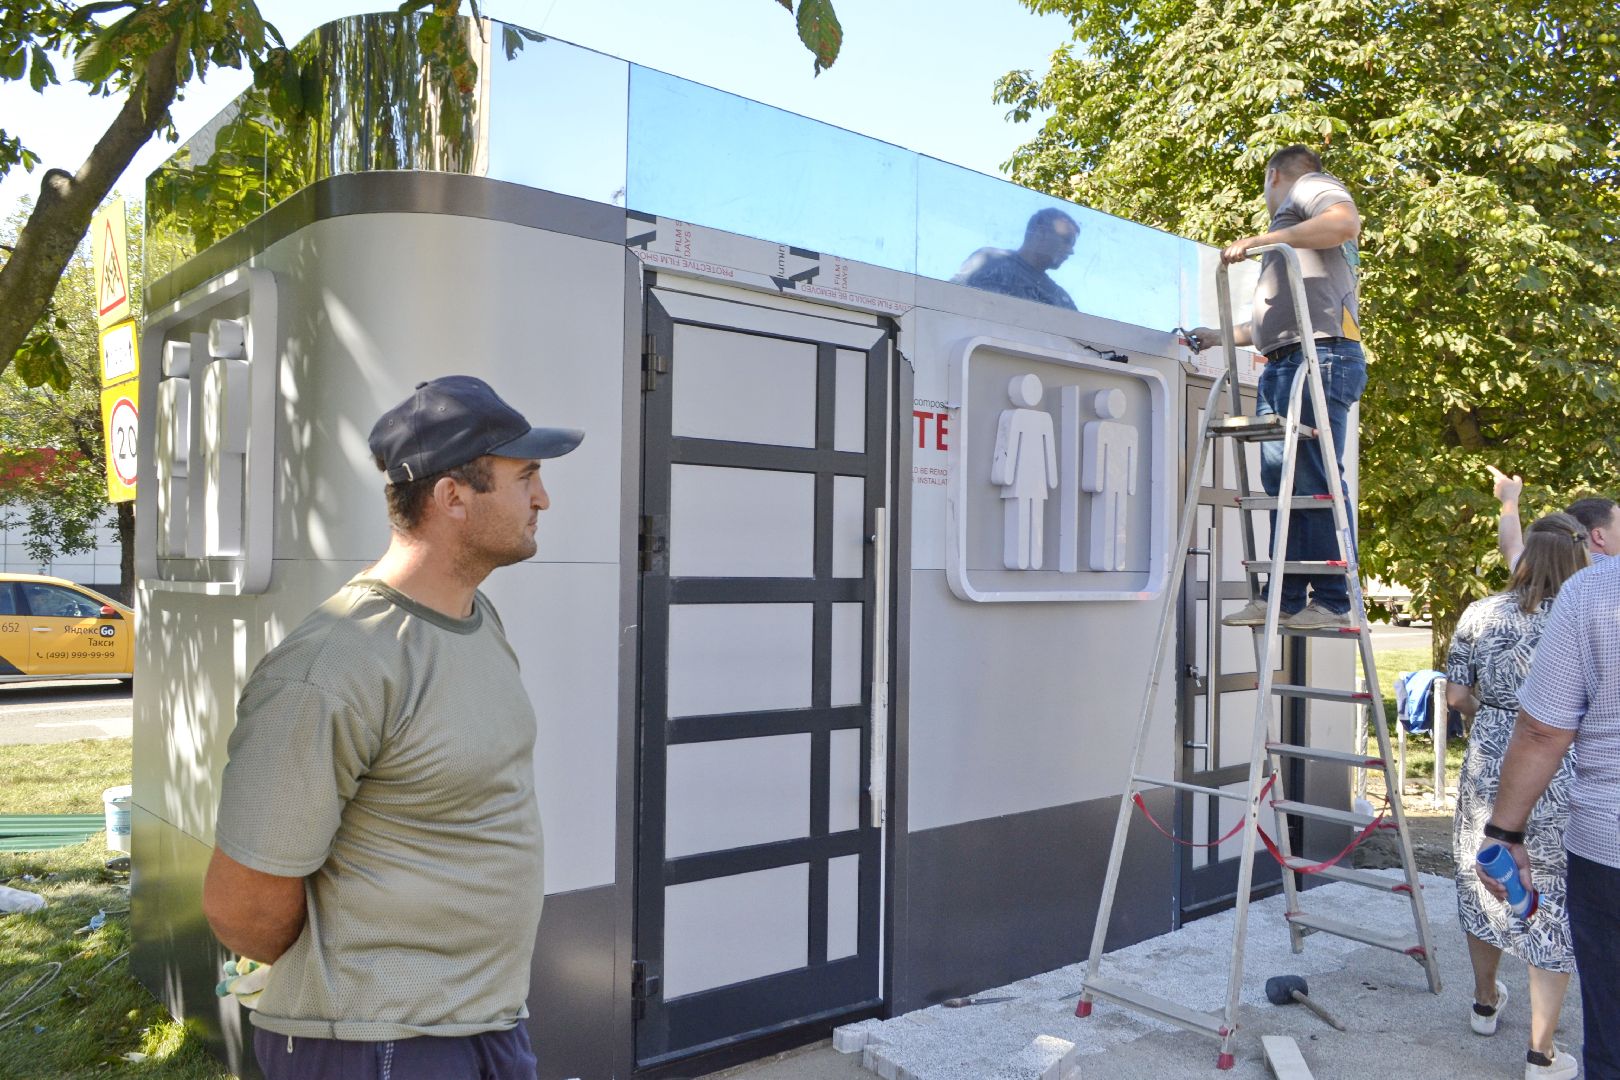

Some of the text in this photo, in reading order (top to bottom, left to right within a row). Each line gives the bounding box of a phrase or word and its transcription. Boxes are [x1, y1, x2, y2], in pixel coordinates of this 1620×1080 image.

[684, 231, 692, 257] DAYS
[660, 255, 680, 267] FILM
[682, 259, 734, 277] PROTECTIVE
[801, 284, 837, 298] REMOVED
[839, 290, 849, 299] BE
[848, 294, 877, 306] SHOULD
[875, 299, 892, 310] FILM
[913, 398, 946, 409] compos
[912, 410, 948, 451] TE
[117, 425, 137, 459] 20
[64, 625, 115, 637] Яндекс Go
[88, 638, 114, 647] Такси
[46, 651, 115, 659] (499) 999-99-99
